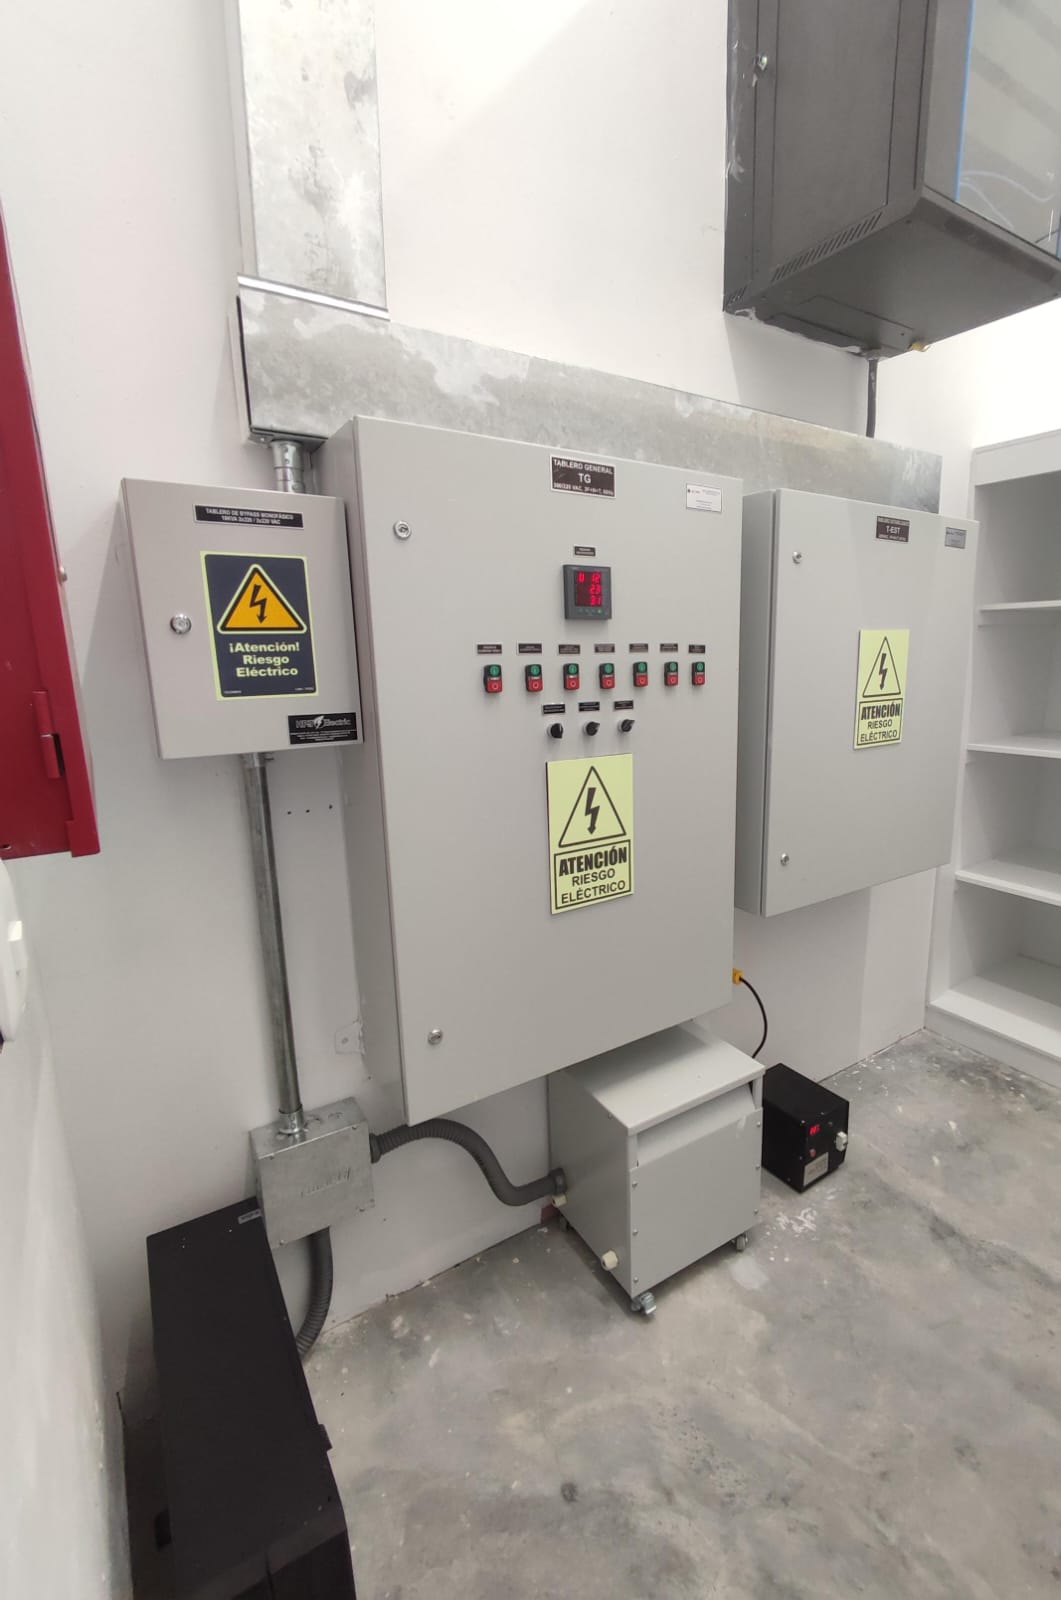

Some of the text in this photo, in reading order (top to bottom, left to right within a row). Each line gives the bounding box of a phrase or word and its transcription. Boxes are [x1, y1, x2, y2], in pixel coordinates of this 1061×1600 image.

[554, 459, 613, 475] TABLERO GENERAL
[578, 473, 592, 484] TG
[205, 507, 231, 516] TABLERO
[239, 510, 260, 518] BYPASS
[229, 641, 300, 653] ¡Atención!
[242, 654, 290, 666] Riesgo
[236, 667, 298, 677] Eléctrico
[861, 701, 901, 721] ATENCIÓN
[867, 719, 893, 730] RIESGO
[860, 729, 898, 743] ELÉCTRICO
[559, 845, 627, 877] ATENCIÓN
[571, 867, 616, 888] RIESGO
[561, 879, 626, 904] ELÉCTRICO
